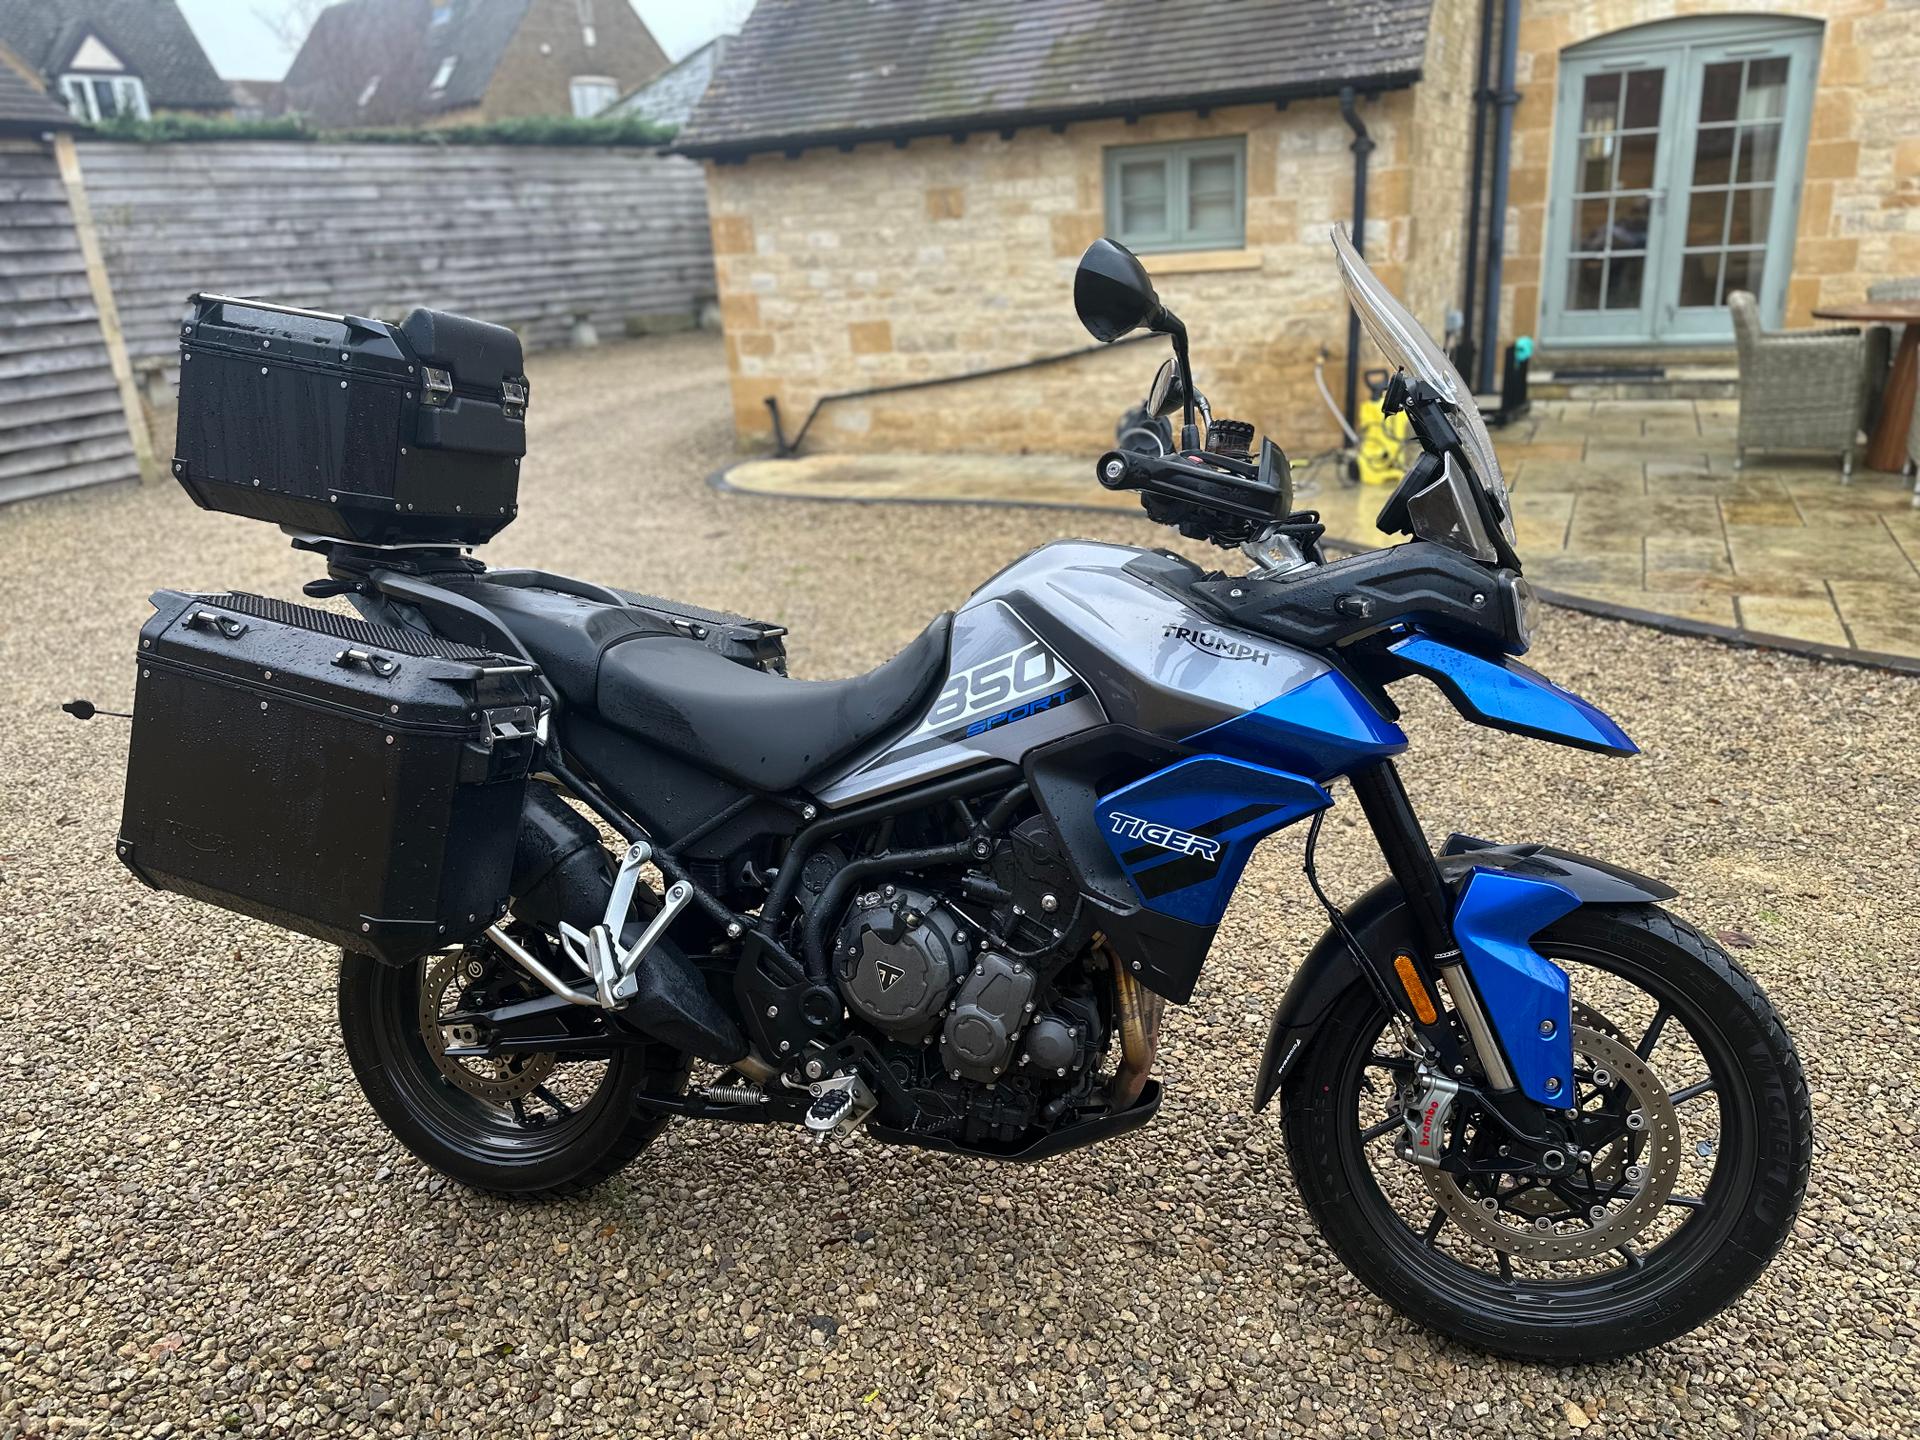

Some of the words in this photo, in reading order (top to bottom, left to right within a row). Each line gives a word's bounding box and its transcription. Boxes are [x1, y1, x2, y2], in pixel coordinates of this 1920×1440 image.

[1162, 624, 1270, 667] TRIUMPH
[926, 643, 1056, 726] 850
[966, 688, 1073, 738] SPORT
[1109, 811, 1220, 862] TIGER
[1418, 1101, 1439, 1147] brembo
